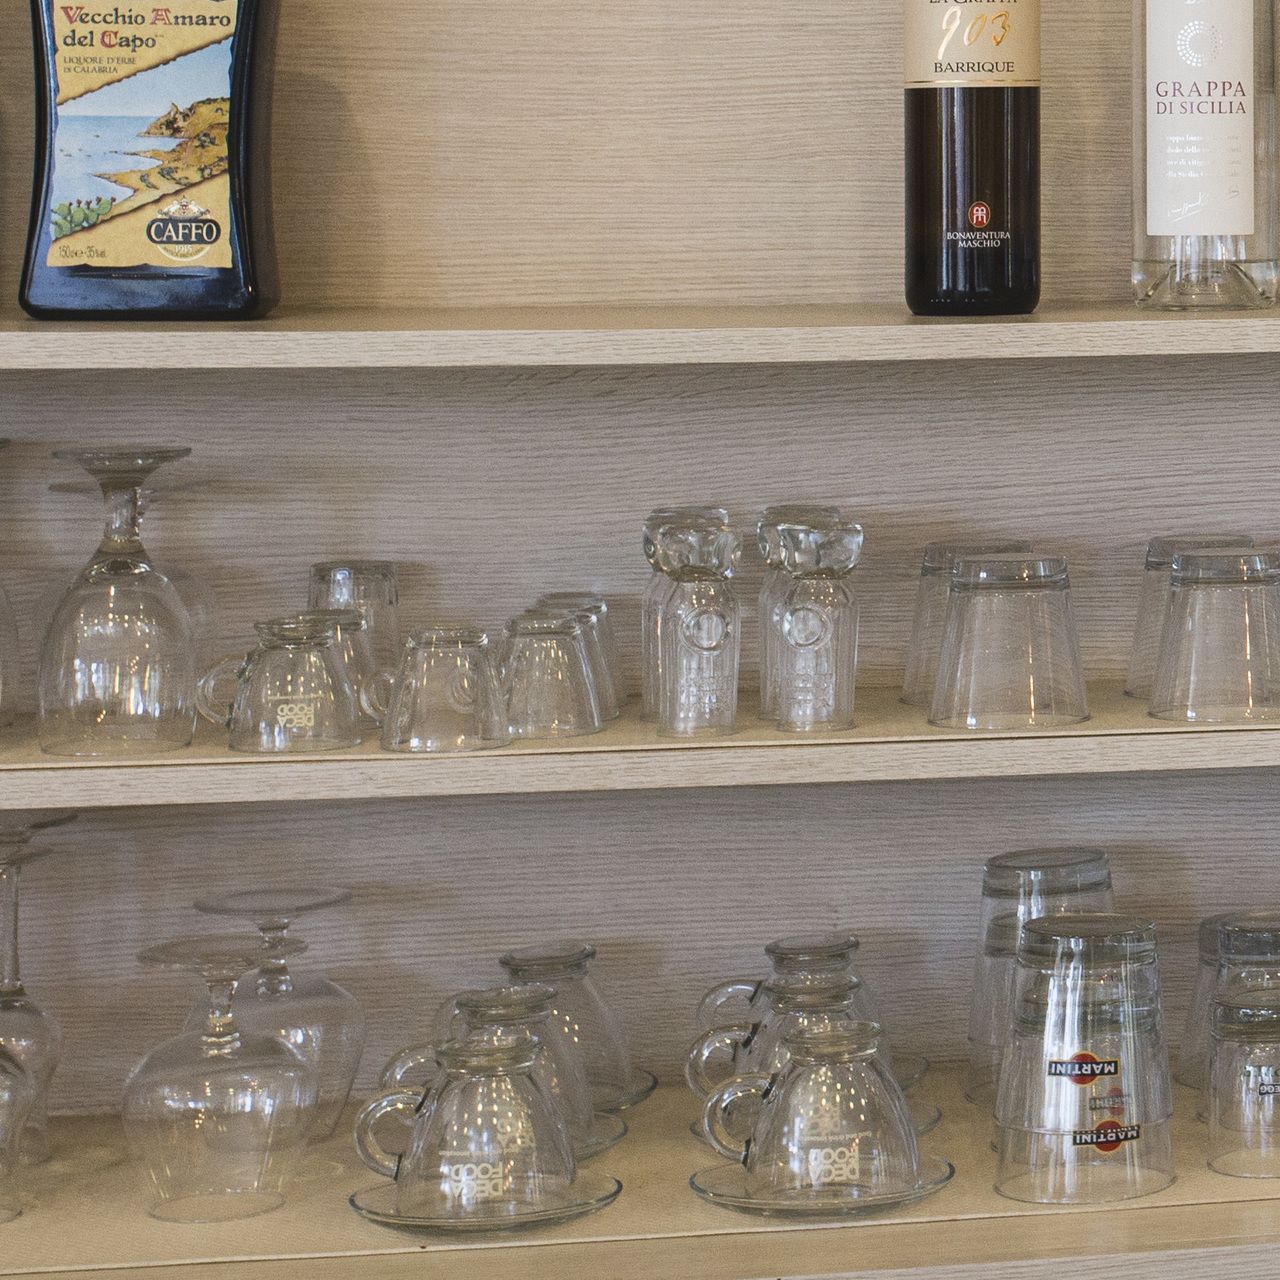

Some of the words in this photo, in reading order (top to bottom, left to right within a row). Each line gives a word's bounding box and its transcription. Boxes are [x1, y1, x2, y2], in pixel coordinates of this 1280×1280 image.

[60, 6, 146, 26] Vecchio
[150, 8, 231, 26] Amaro
[938, 6, 1011, 60] 903
[62, 29, 94, 48] del
[100, 30, 157, 53] Capo
[63, 55, 103, 65] LIQUORE
[73, 65, 118, 74] CALABRIA
[934, 61, 1015, 74] BARRIQUE
[1156, 80, 1247, 97] GRAPPA
[1156, 101, 1173, 114] DI
[1180, 100, 1247, 114] SICILIA
[150, 221, 217, 242] CAFFO
[947, 230, 1011, 240] BONAVENTURA
[958, 239, 1001, 248] MASCHIO
[276, 703, 315, 716] FOOD
[276, 714, 315, 728] DECA
[1051, 1062, 1115, 1074] MARTINI
[450, 1161, 504, 1180] FOOD
[808, 1164, 860, 1183] DECA
[450, 1179, 504, 1199] DECA
